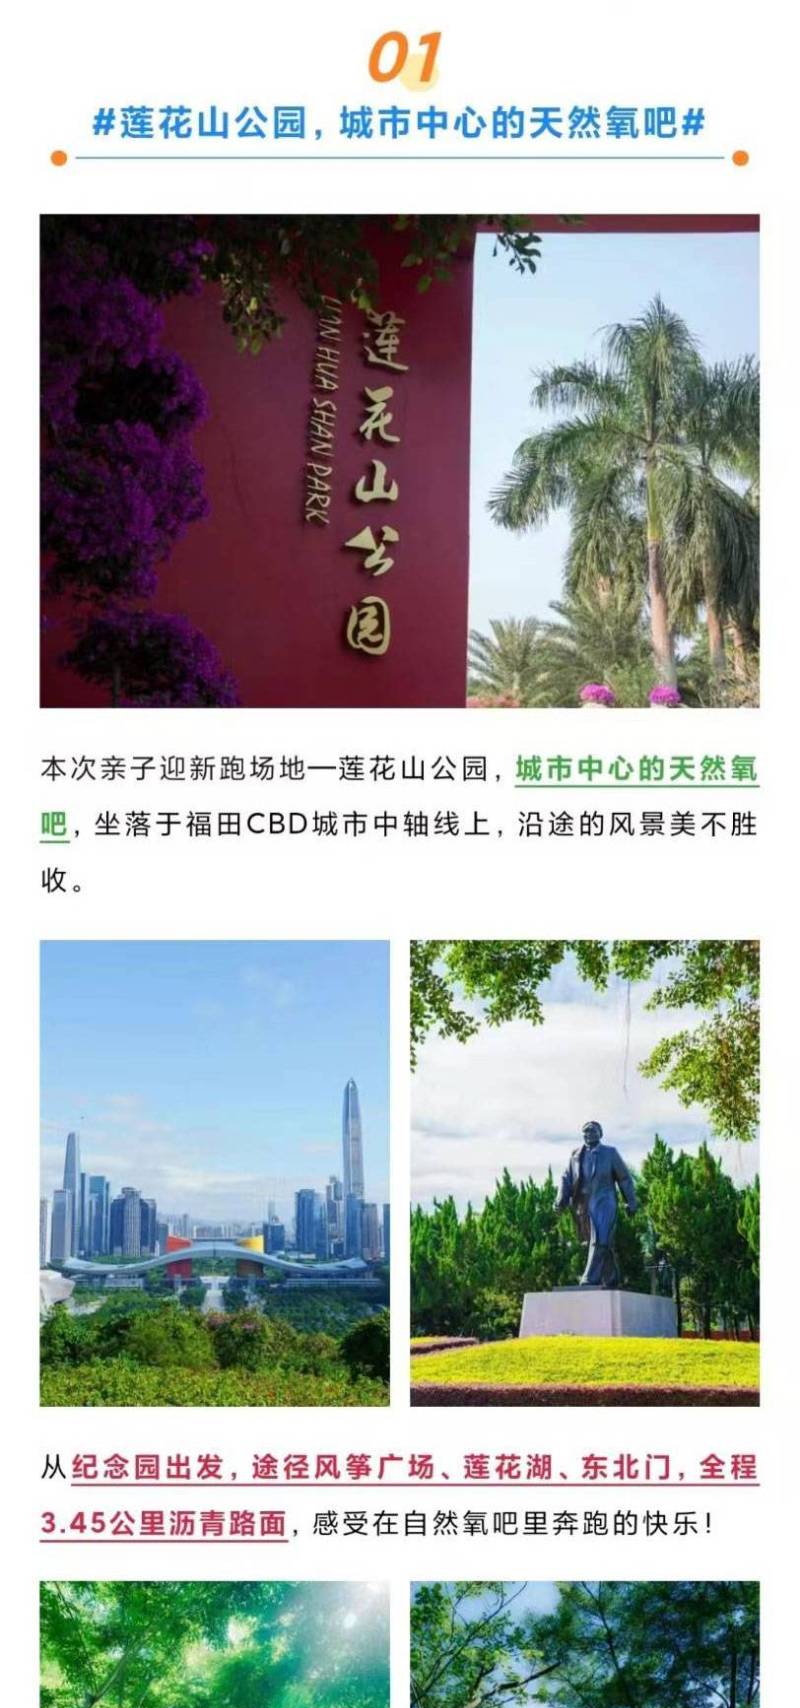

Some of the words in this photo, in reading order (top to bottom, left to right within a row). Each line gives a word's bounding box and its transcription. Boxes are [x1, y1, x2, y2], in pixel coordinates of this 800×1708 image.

[368, 30, 442, 83] 01
[314, 347, 340, 391] HUA
[310, 397, 337, 456] SHAN
[305, 462, 333, 524] PARK
[345, 309, 409, 656] 莲花山公园
[42, 867, 83, 894] 收。
